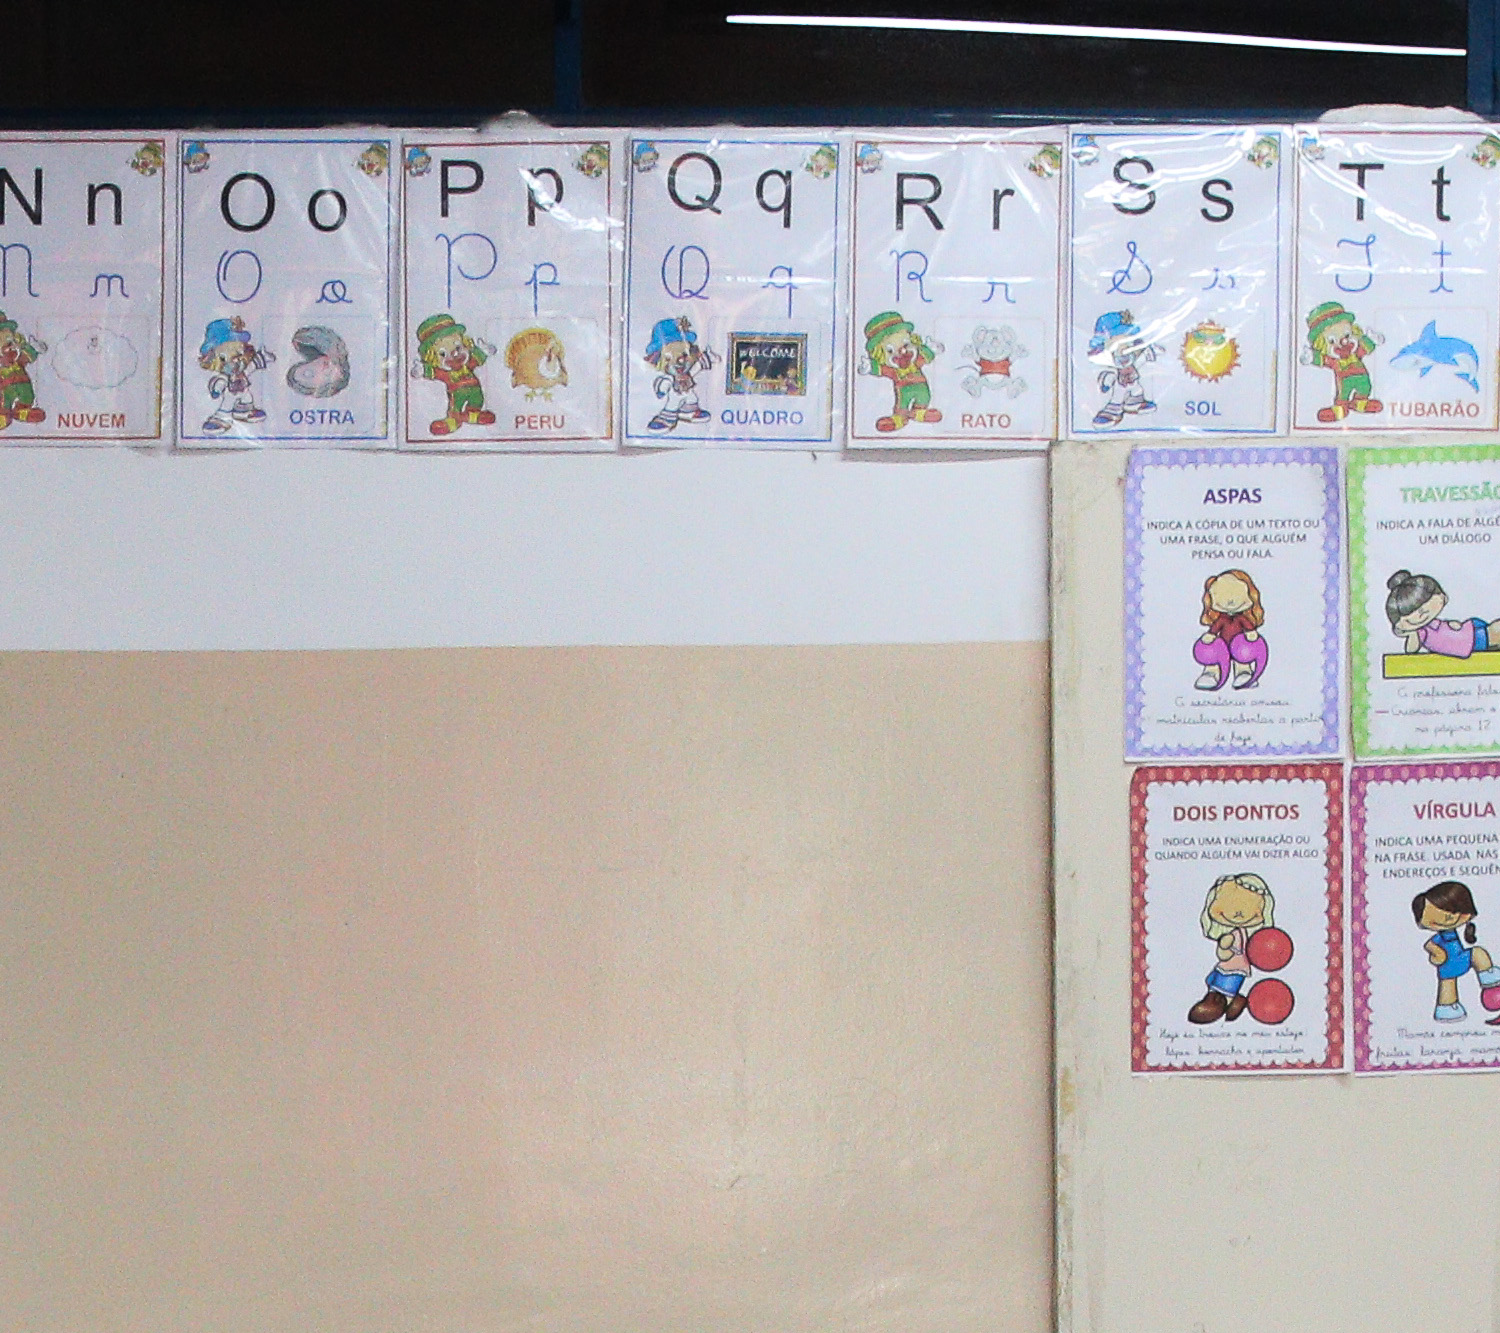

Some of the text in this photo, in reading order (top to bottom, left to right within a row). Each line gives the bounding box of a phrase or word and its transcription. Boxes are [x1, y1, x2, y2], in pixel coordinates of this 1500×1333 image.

[440, 160, 564, 226] P p
[667, 152, 792, 228] Q q
[1113, 157, 1234, 222] S s
[1339, 163, 1451, 222] T t
[87, 182, 123, 226] n
[220, 173, 347, 232] O o
[897, 173, 1014, 231] R r
[1184, 401, 1221, 416] SOL
[1389, 398, 1479, 418] TUBARÃO
[58, 413, 126, 428] NUVEM
[289, 410, 354, 424] OSTRA
[514, 414, 566, 429] PERU
[721, 409, 803, 427] QUADRO
[961, 413, 1011, 429] RATO
[1204, 488, 1262, 504] ASPAS
[1147, 520, 1182, 530] INDICA
[1186, 521, 1192, 529] A
[1230, 520, 1242, 529] DE
[1247, 520, 1265, 529] UM
[1269, 520, 1300, 528] TEXTO
[1304, 519, 1319, 528] OU
[1376, 520, 1414, 530] INDICA
[1417, 520, 1426, 529] A
[1429, 519, 1453, 528] FALA
[1457, 518, 1470, 527] DE
[1160, 536, 1185, 544] UMA
[1226, 535, 1233, 543] O
[1237, 535, 1258, 544] QUE
[1263, 533, 1307, 543] ALGUÉM
[1420, 532, 1491, 544] UM DIÁLOGO
[1192, 551, 1223, 559] PENSA
[1228, 550, 1243, 559] OU
[1173, 805, 1299, 821] DOIS PONTOS
[1414, 800, 1496, 820] VÍRGULA
